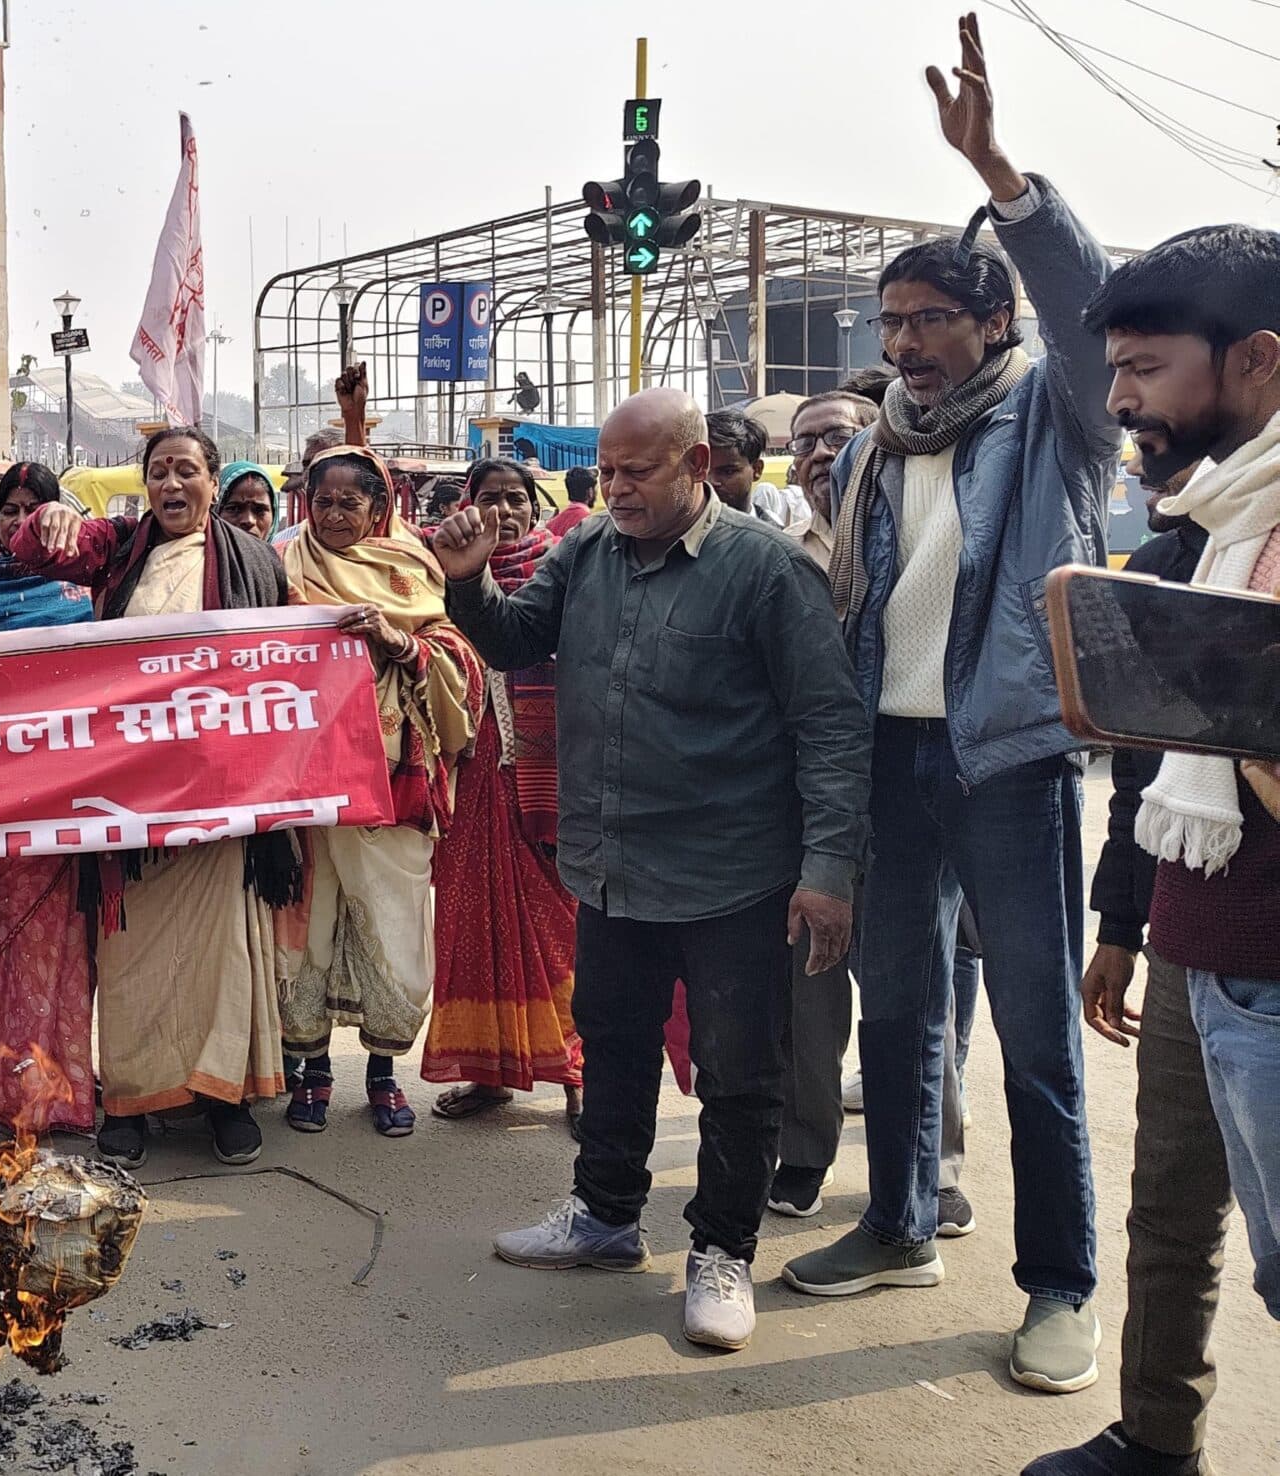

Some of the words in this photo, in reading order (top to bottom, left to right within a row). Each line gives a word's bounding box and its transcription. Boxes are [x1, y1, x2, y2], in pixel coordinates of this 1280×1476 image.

[635, 106, 648, 132] 6
[431, 297, 446, 321] P
[477, 298, 487, 321] P
[423, 356, 451, 372] Parking
[138, 646, 221, 674] नारी
[230, 640, 321, 672] मुक्ति
[109, 680, 320, 744] समिति
